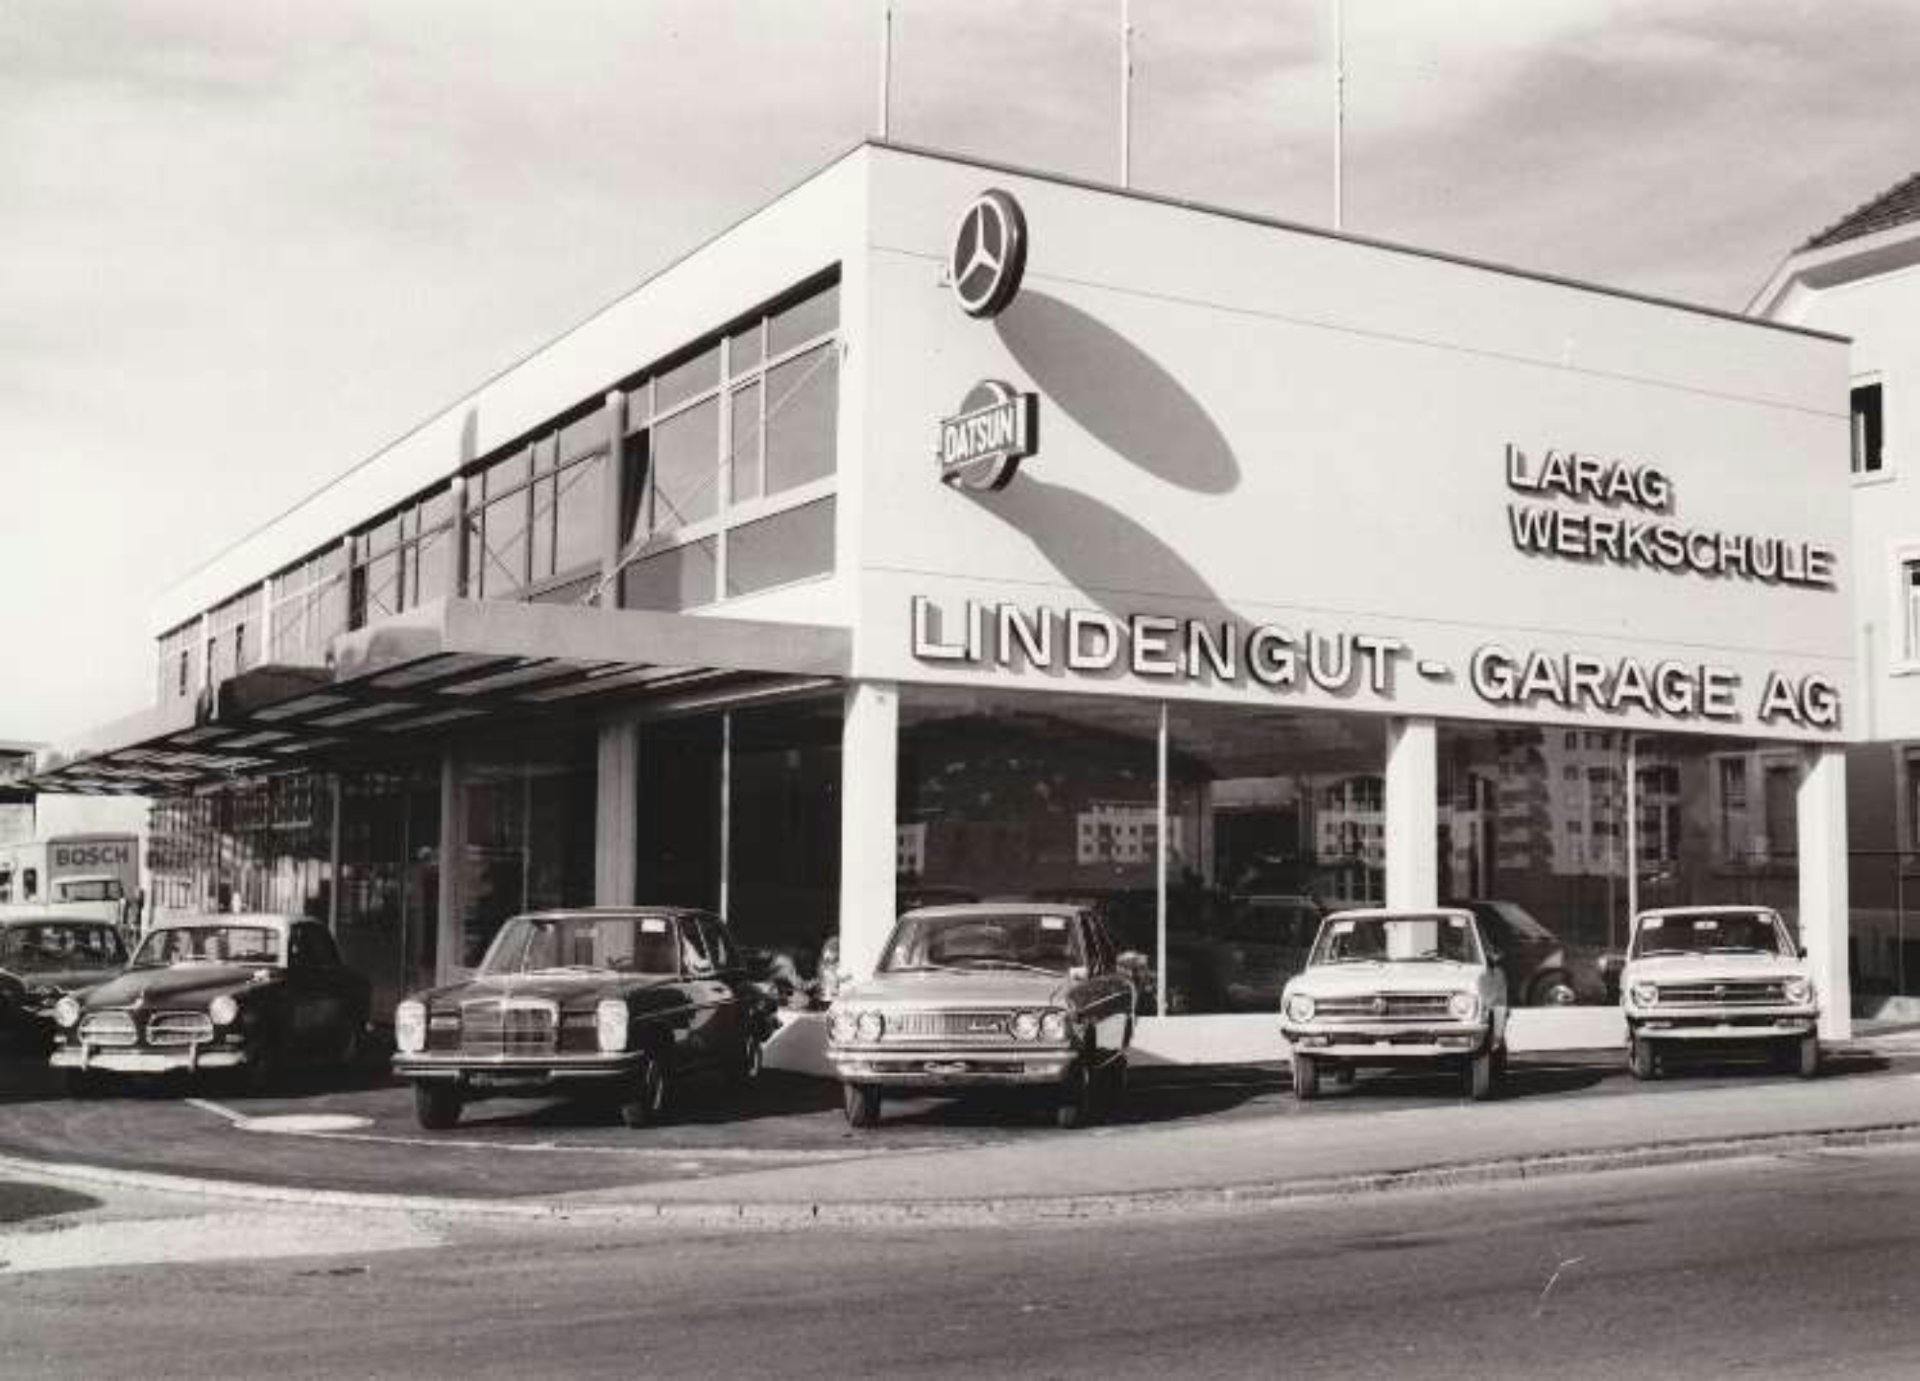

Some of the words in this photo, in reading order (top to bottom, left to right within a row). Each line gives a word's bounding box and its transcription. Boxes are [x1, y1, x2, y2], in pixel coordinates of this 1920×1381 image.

[944, 404, 1017, 463] DATSUN
[1507, 443, 1670, 507] LARAG
[1509, 504, 1837, 587] WERKSCHULE
[913, 595, 1402, 691] LINDENGUT
[1472, 644, 1742, 717] GARAGE
[1760, 671, 1840, 723] AG
[56, 846, 129, 866] BOSCH
